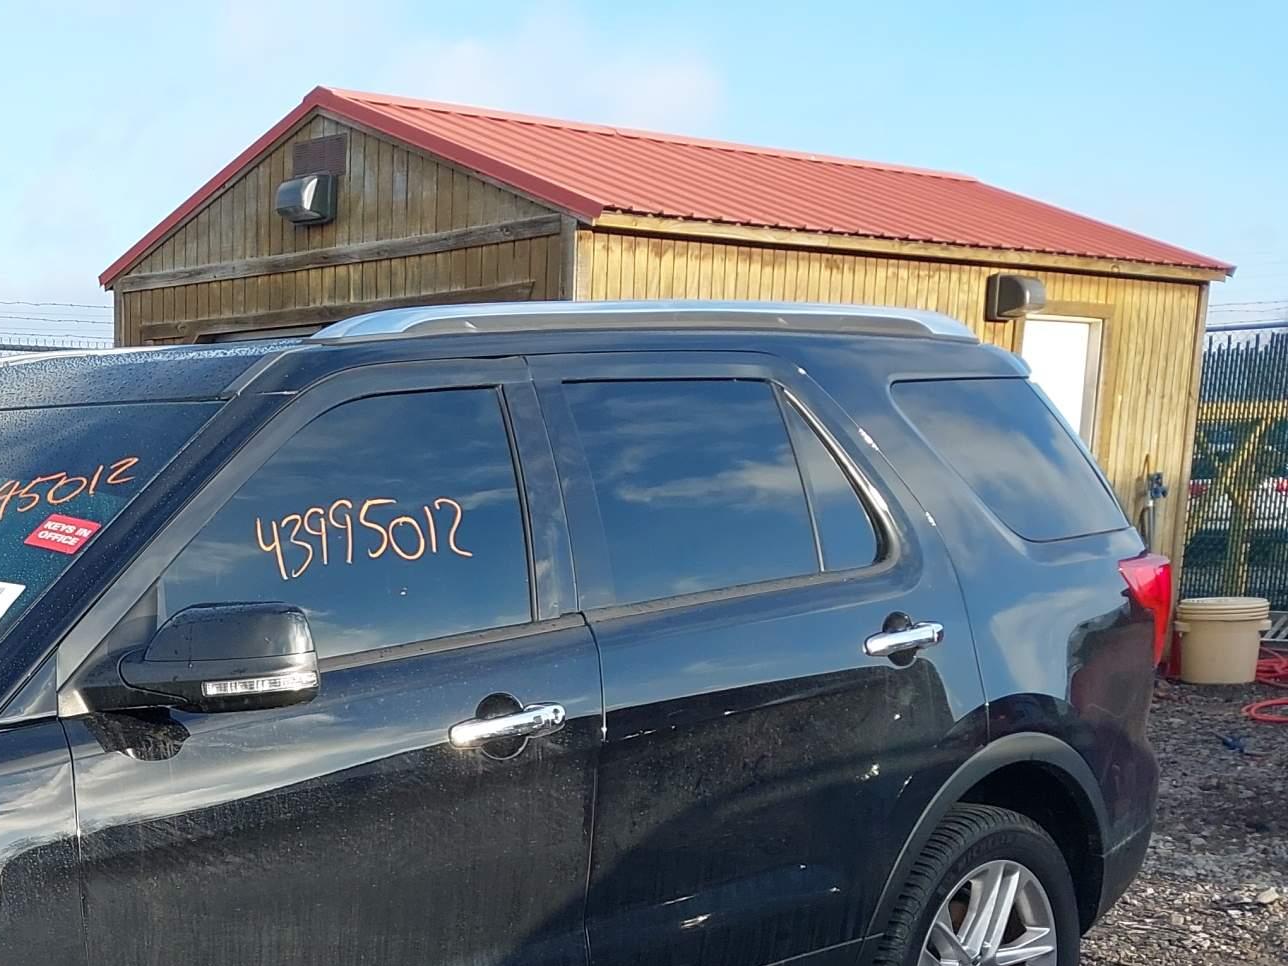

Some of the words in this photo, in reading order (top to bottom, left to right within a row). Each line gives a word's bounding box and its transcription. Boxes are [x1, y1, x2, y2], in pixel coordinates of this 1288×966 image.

[44, 521, 76, 533] KEYS
[75, 528, 92, 537] IN
[38, 531, 79, 545] OFFICE
[256, 498, 473, 580] 43995012
